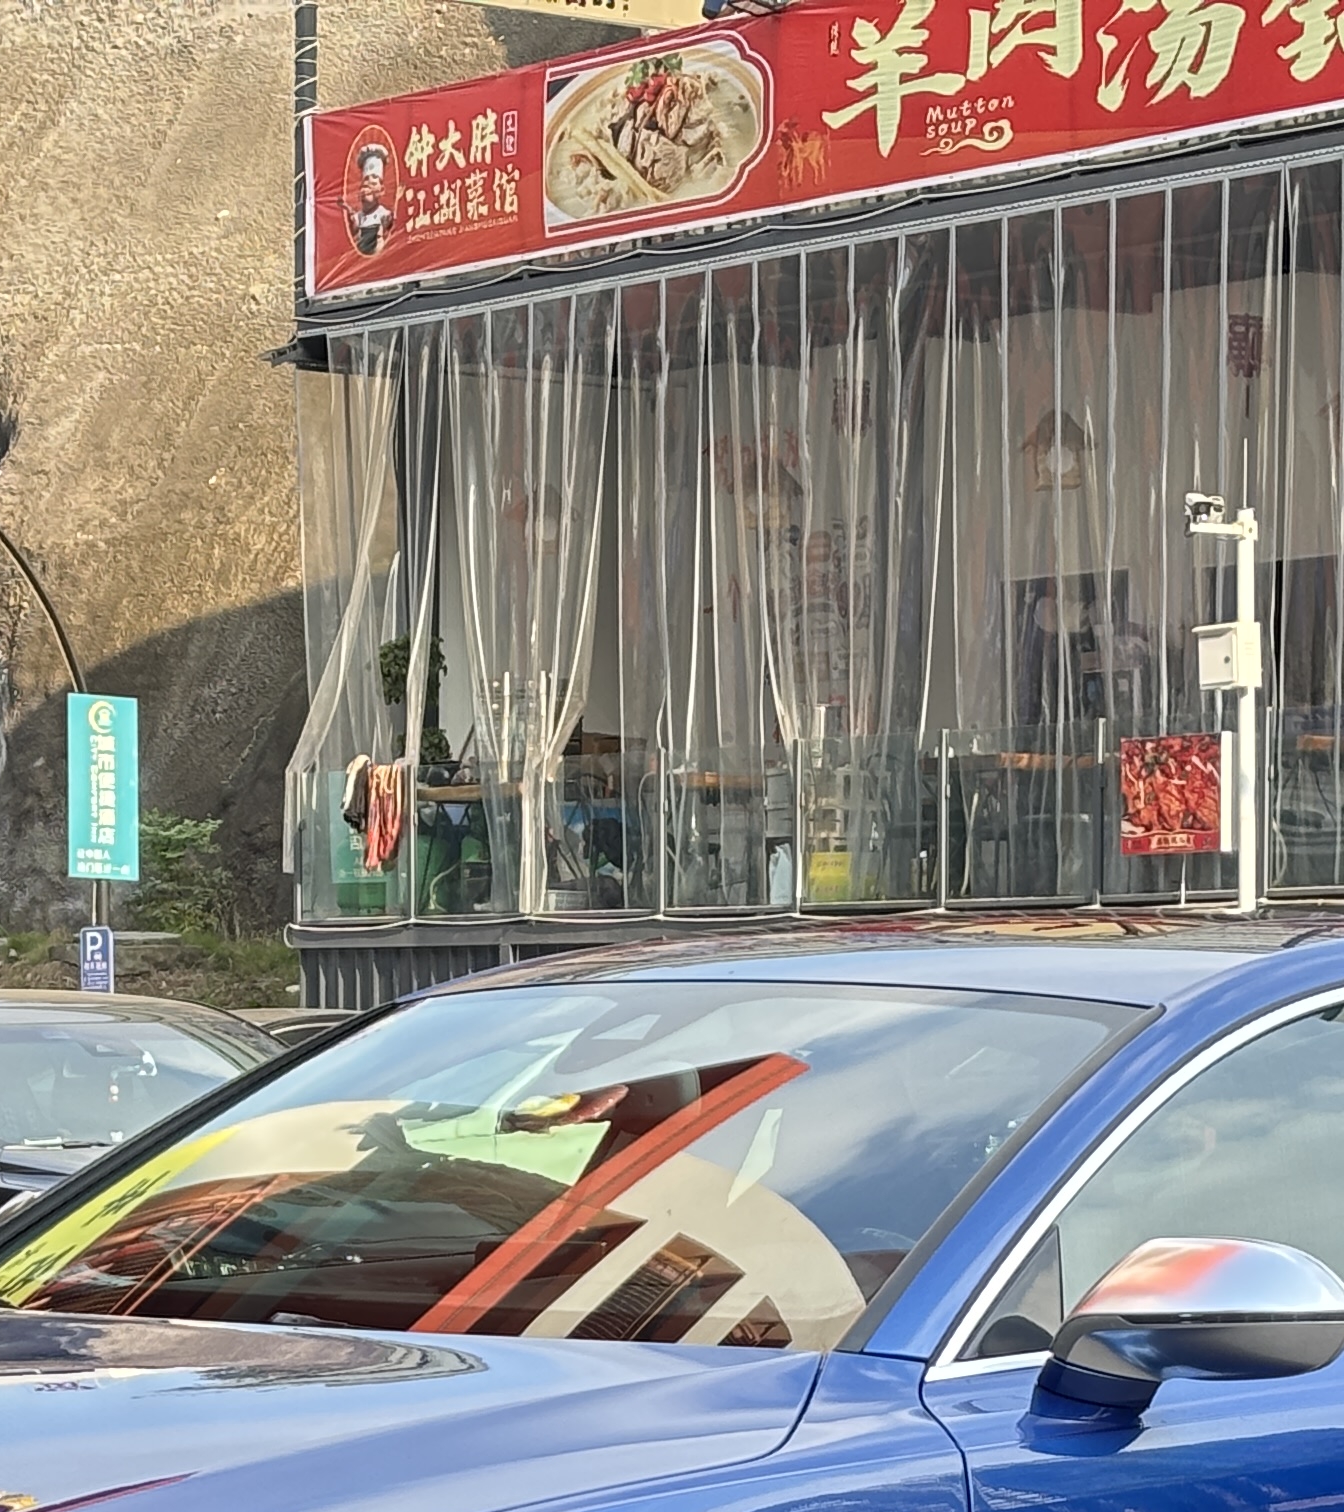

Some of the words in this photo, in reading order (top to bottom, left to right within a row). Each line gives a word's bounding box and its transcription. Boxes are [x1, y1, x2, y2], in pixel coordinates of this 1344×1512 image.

[926, 94, 1015, 125] Mutton
[404, 107, 499, 178] 钟大胖
[925, 117, 978, 140] soup
[405, 163, 520, 232] 江湖菜馆
[86, 931, 103, 962] P
